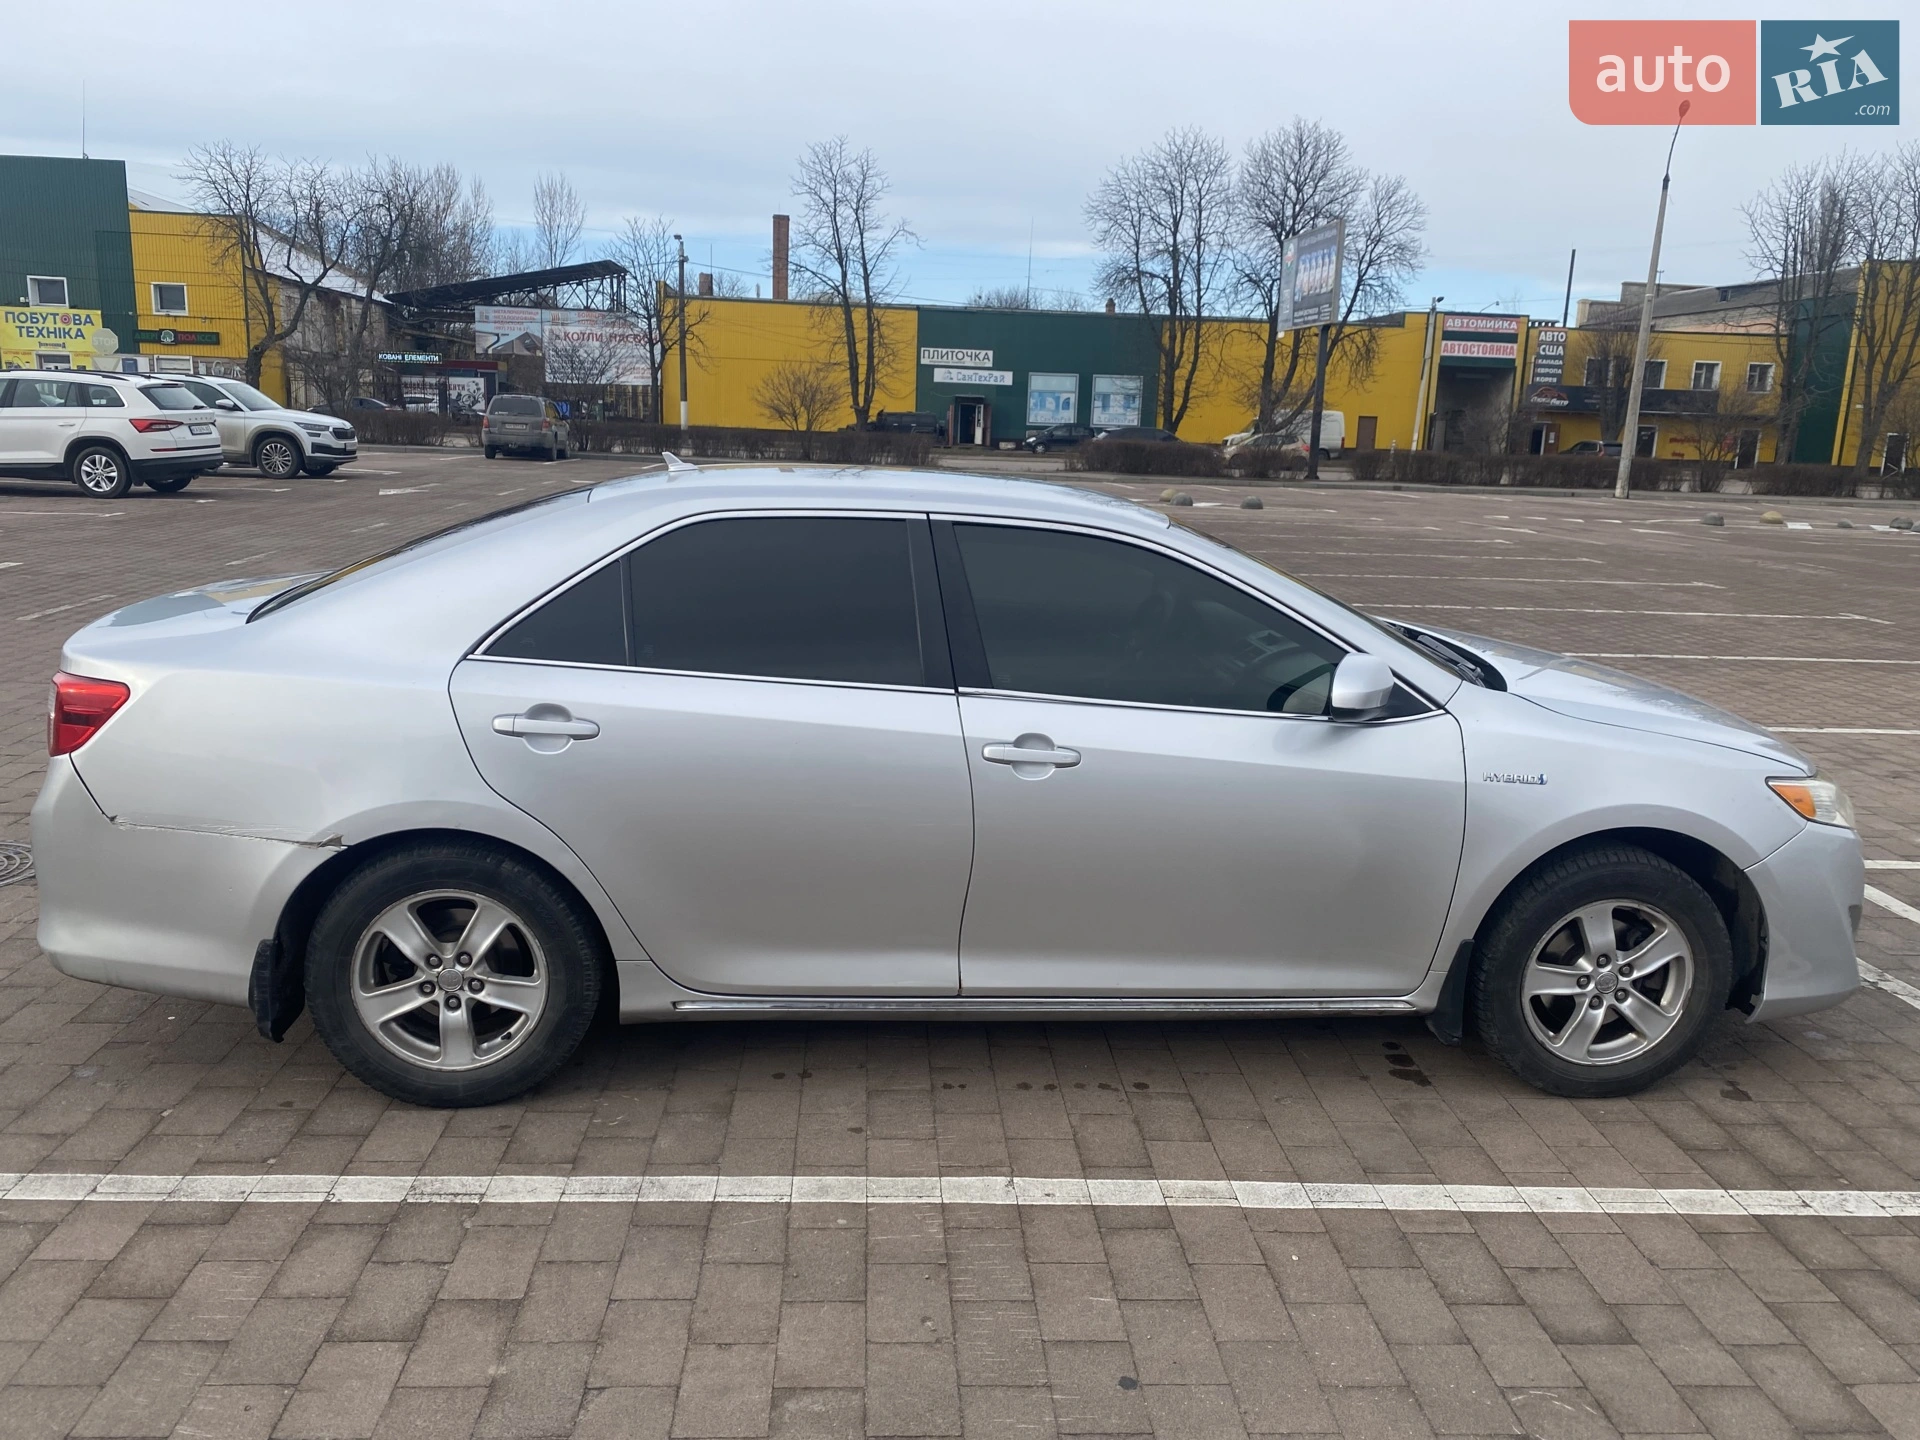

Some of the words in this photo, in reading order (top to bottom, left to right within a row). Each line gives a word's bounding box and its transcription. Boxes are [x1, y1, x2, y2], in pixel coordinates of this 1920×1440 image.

[4, 311, 94, 326] ПОБУТОВА
[1446, 317, 1518, 329] АВТОМИЙКА
[15, 326, 86, 340] ТЕХНІКА
[563, 331, 603, 342] КОТЛИ
[1539, 331, 1566, 342] АВТО
[1442, 342, 1515, 356] АВТОСТОЯНКА
[1539, 344, 1564, 356] США
[922, 349, 991, 362] ПЛИТОЧКА
[1482, 772, 1539, 784] HYBRID
